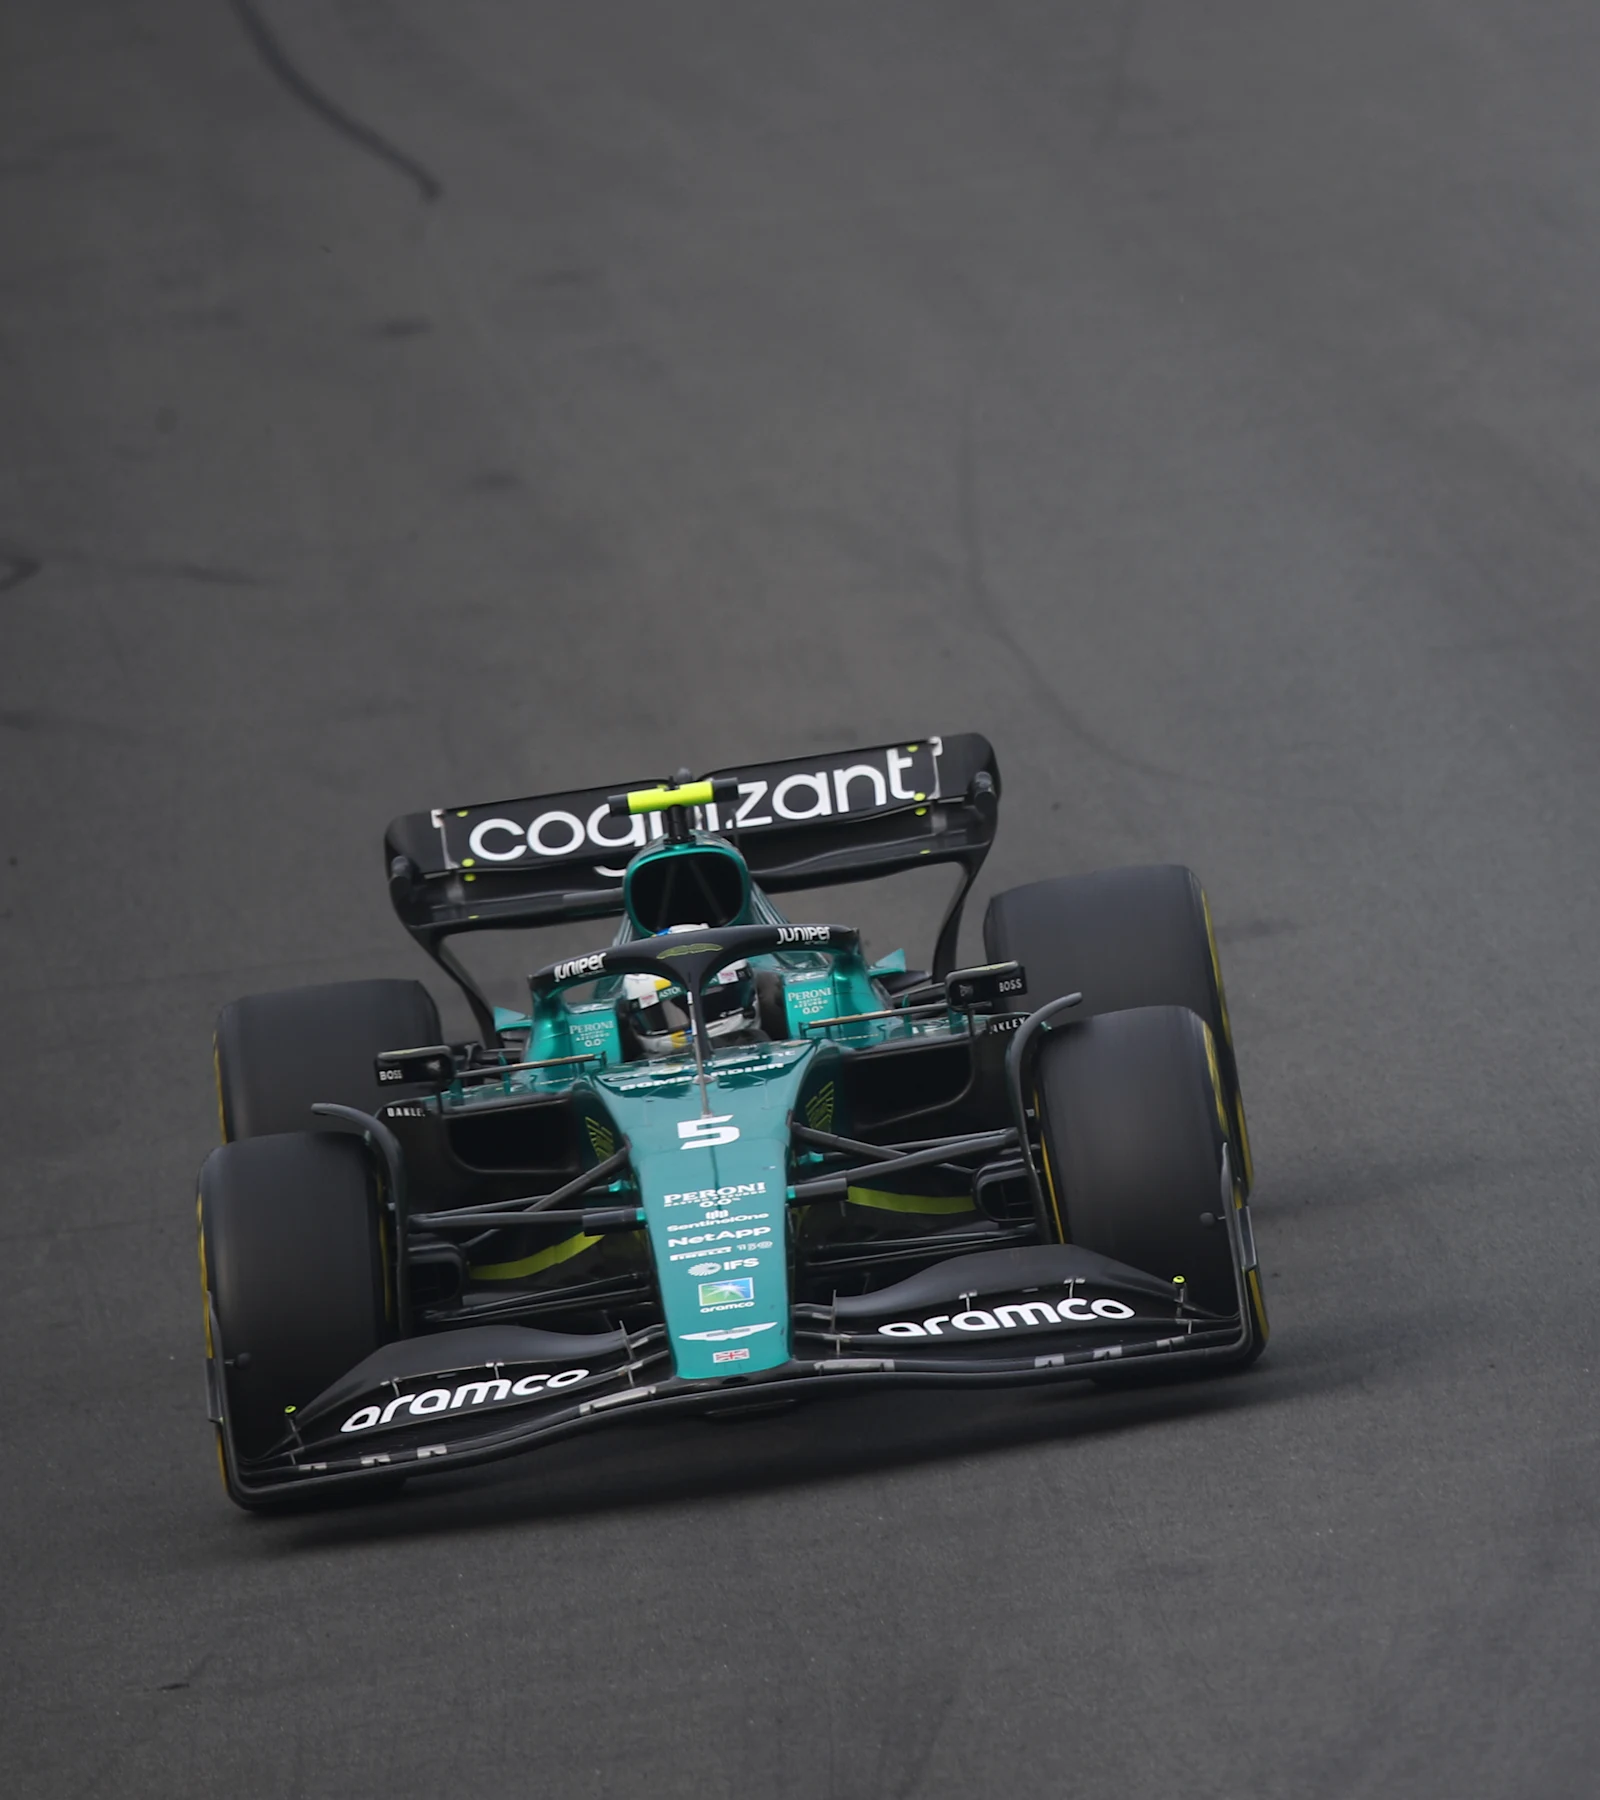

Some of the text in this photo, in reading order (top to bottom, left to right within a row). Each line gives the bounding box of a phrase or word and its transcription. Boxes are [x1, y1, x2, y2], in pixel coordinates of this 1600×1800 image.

[787, 987, 832, 1002] PERONI
[999, 978, 1022, 993] BOSS
[569, 1020, 614, 1035] PERONI
[988, 1017, 1027, 1035] AKLEY
[620, 1062, 784, 1093] BOMBRDIER
[677, 1114, 741, 1150] 5
[663, 1182, 766, 1205] PERONI
[667, 1213, 769, 1232] SentinelOne
[668, 1226, 771, 1248] NetApp
[723, 1257, 760, 1271] IFS
[700, 1301, 755, 1314] aramco
[878, 1296, 1135, 1338] aramco
[339, 1368, 591, 1433] aramco
